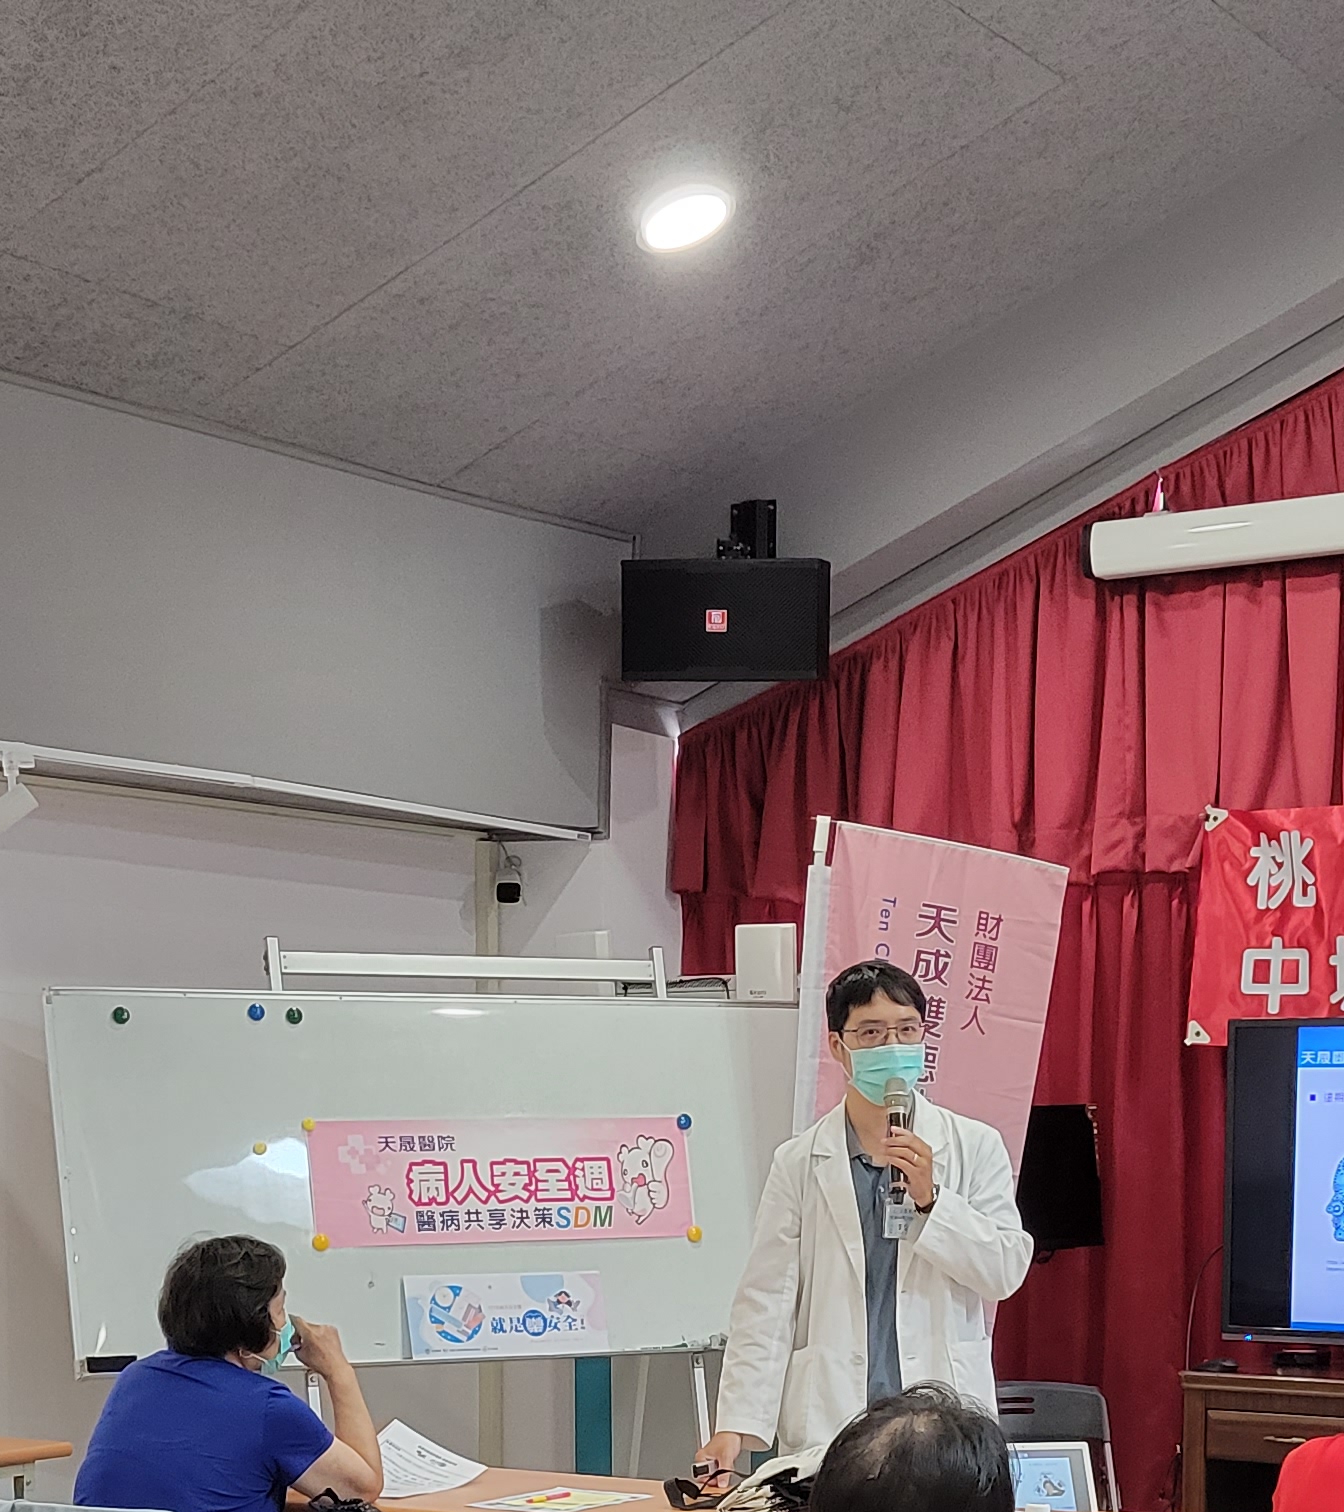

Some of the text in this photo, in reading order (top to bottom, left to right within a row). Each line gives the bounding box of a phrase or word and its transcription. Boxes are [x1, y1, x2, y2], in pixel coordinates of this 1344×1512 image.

[877, 896, 898, 932] Ten
[959, 910, 1005, 1036] 財團法人
[376, 1134, 457, 1154] 天晟醫院
[407, 1157, 615, 1207] 病人安全週
